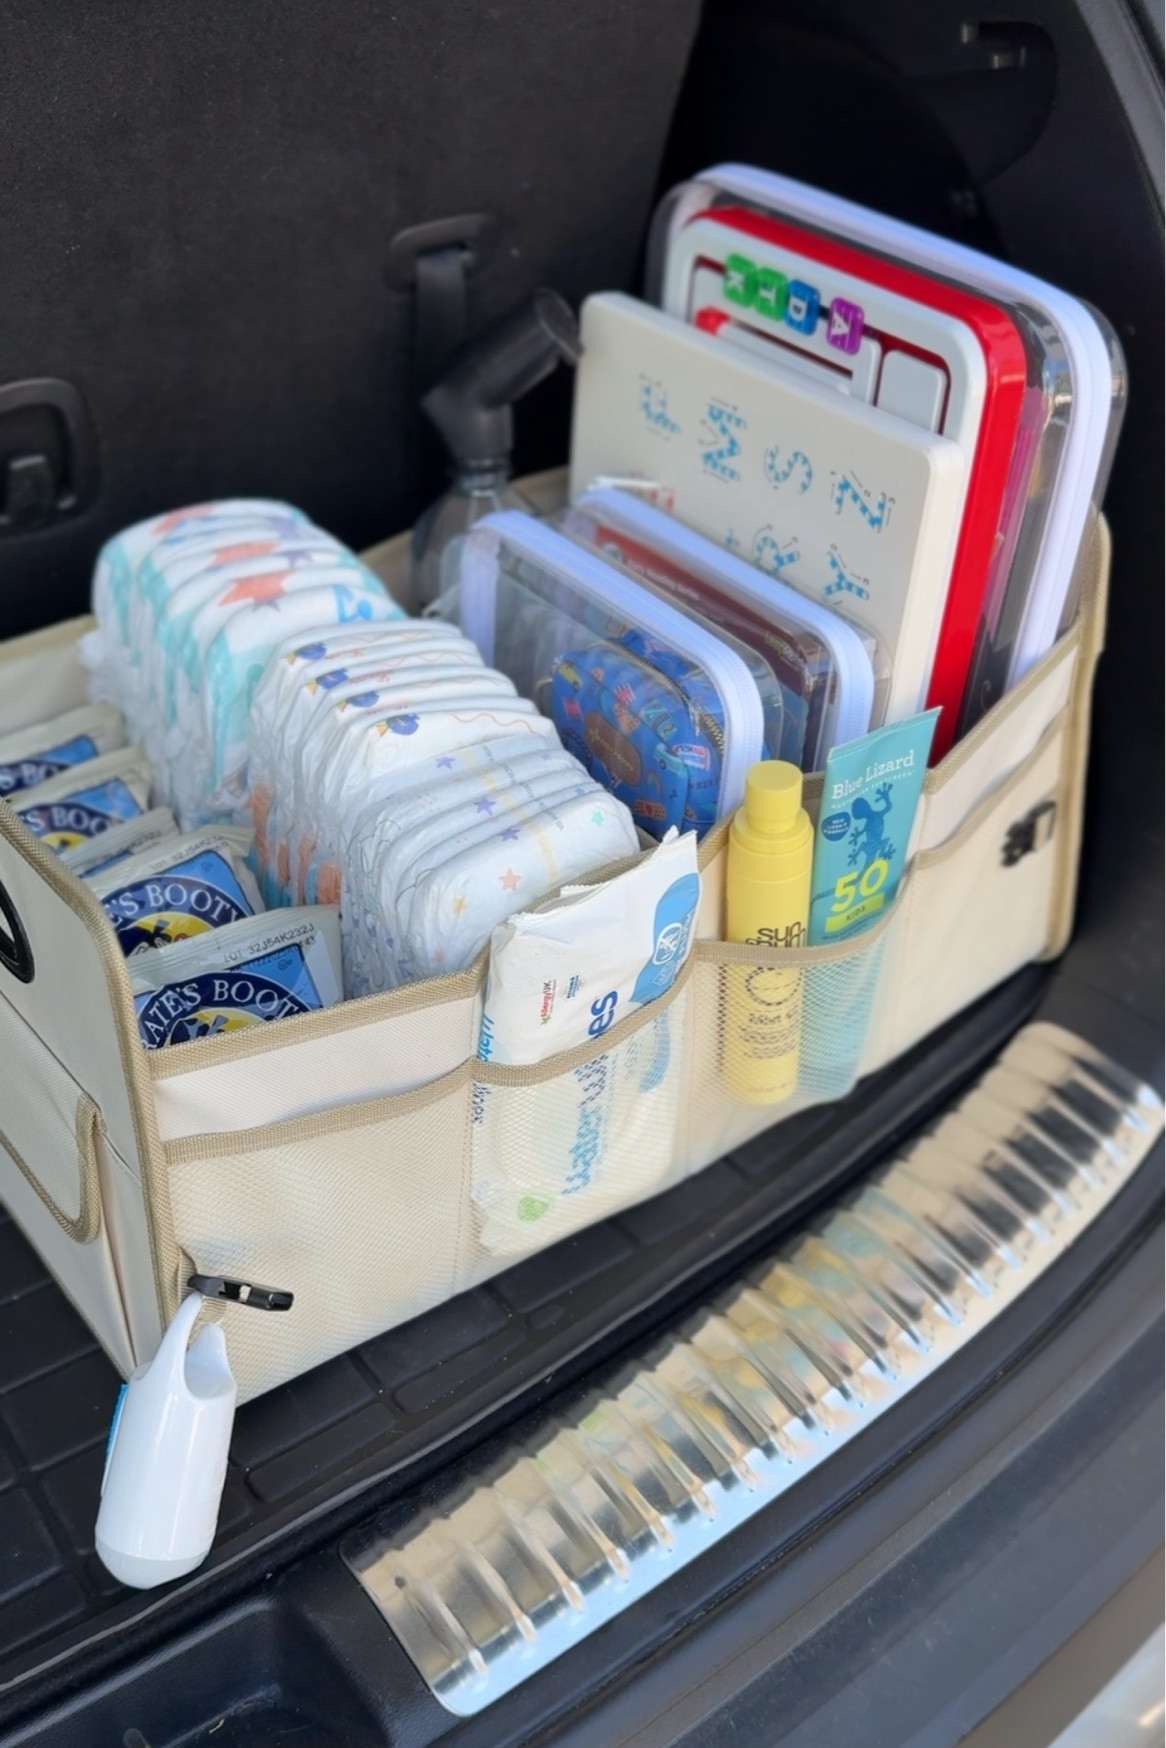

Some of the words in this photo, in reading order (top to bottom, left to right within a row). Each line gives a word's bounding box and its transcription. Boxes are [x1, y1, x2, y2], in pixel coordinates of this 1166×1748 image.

[702, 403, 747, 481] M
[767, 446, 813, 495] S
[824, 550, 870, 600] Y
[831, 779, 863, 800] Blue
[865, 748, 915, 782] Lizard
[830, 856, 889, 912] 50
